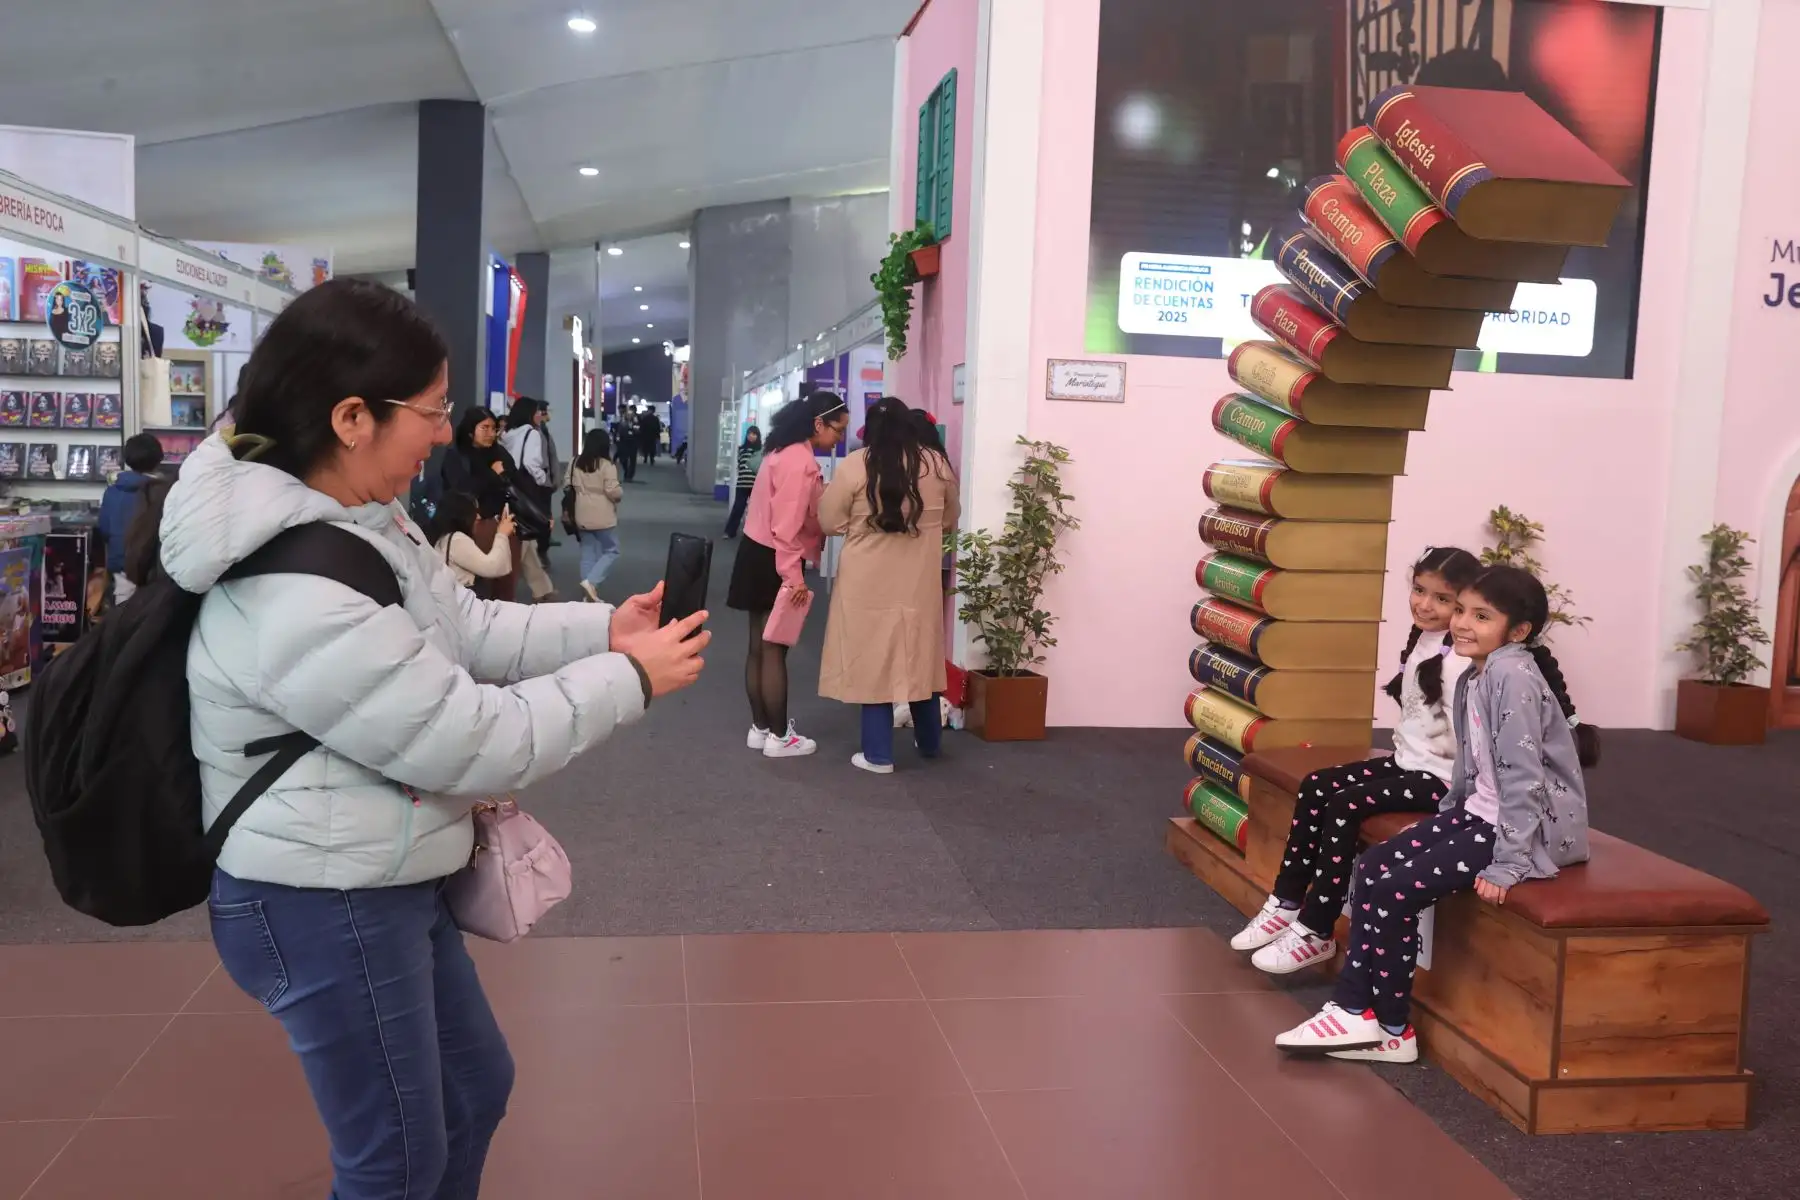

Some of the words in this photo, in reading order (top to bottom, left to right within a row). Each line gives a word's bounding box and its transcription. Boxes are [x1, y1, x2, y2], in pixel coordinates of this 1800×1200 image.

[1362, 160, 1397, 208] Plaza
[1321, 198, 1363, 245] Campo
[176, 258, 206, 281] EDICIONES
[1293, 248, 1329, 289] Parque
[1135, 276, 1214, 293] RENDICIÓN
[1133, 294, 1150, 306] DE
[1154, 295, 1213, 309] CUENTAS
[1158, 310, 1188, 322] 2025
[1273, 308, 1298, 338] Plaza
[1230, 406, 1266, 435] Campo
[1207, 652, 1240, 678] Parque
[1197, 749, 1234, 782] Nunciatura
[1201, 803, 1226, 829] Edgardo
